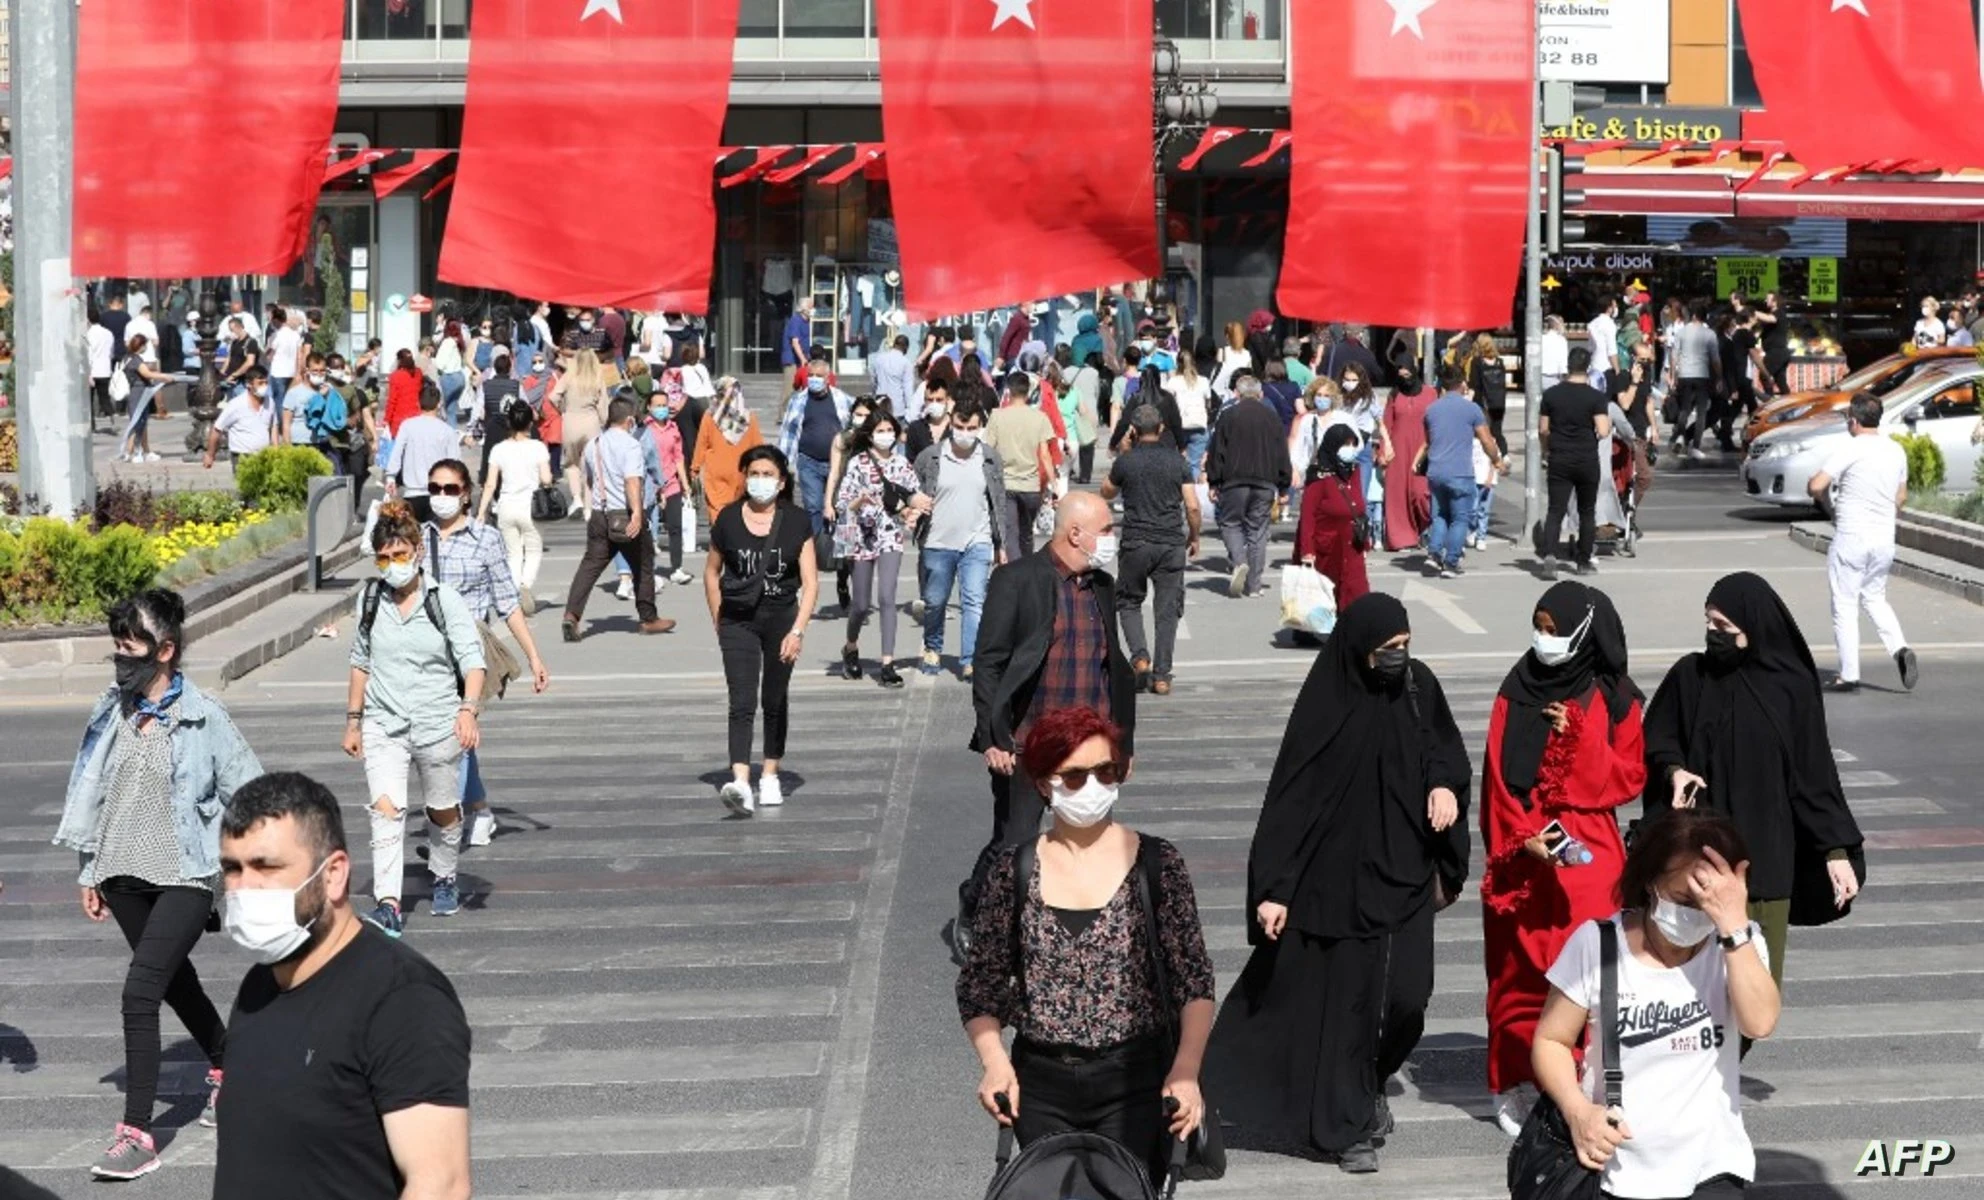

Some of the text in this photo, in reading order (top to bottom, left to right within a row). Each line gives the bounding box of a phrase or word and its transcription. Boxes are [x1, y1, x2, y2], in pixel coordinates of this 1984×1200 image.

[1570, 53, 1598, 65] 88
[1602, 118, 1628, 139] &
[1634, 117, 1722, 141] bistro
[1736, 276, 1760, 295] 89
[1617, 1000, 1708, 1035] Hilfiger
[1700, 1024, 1725, 1050] 85
